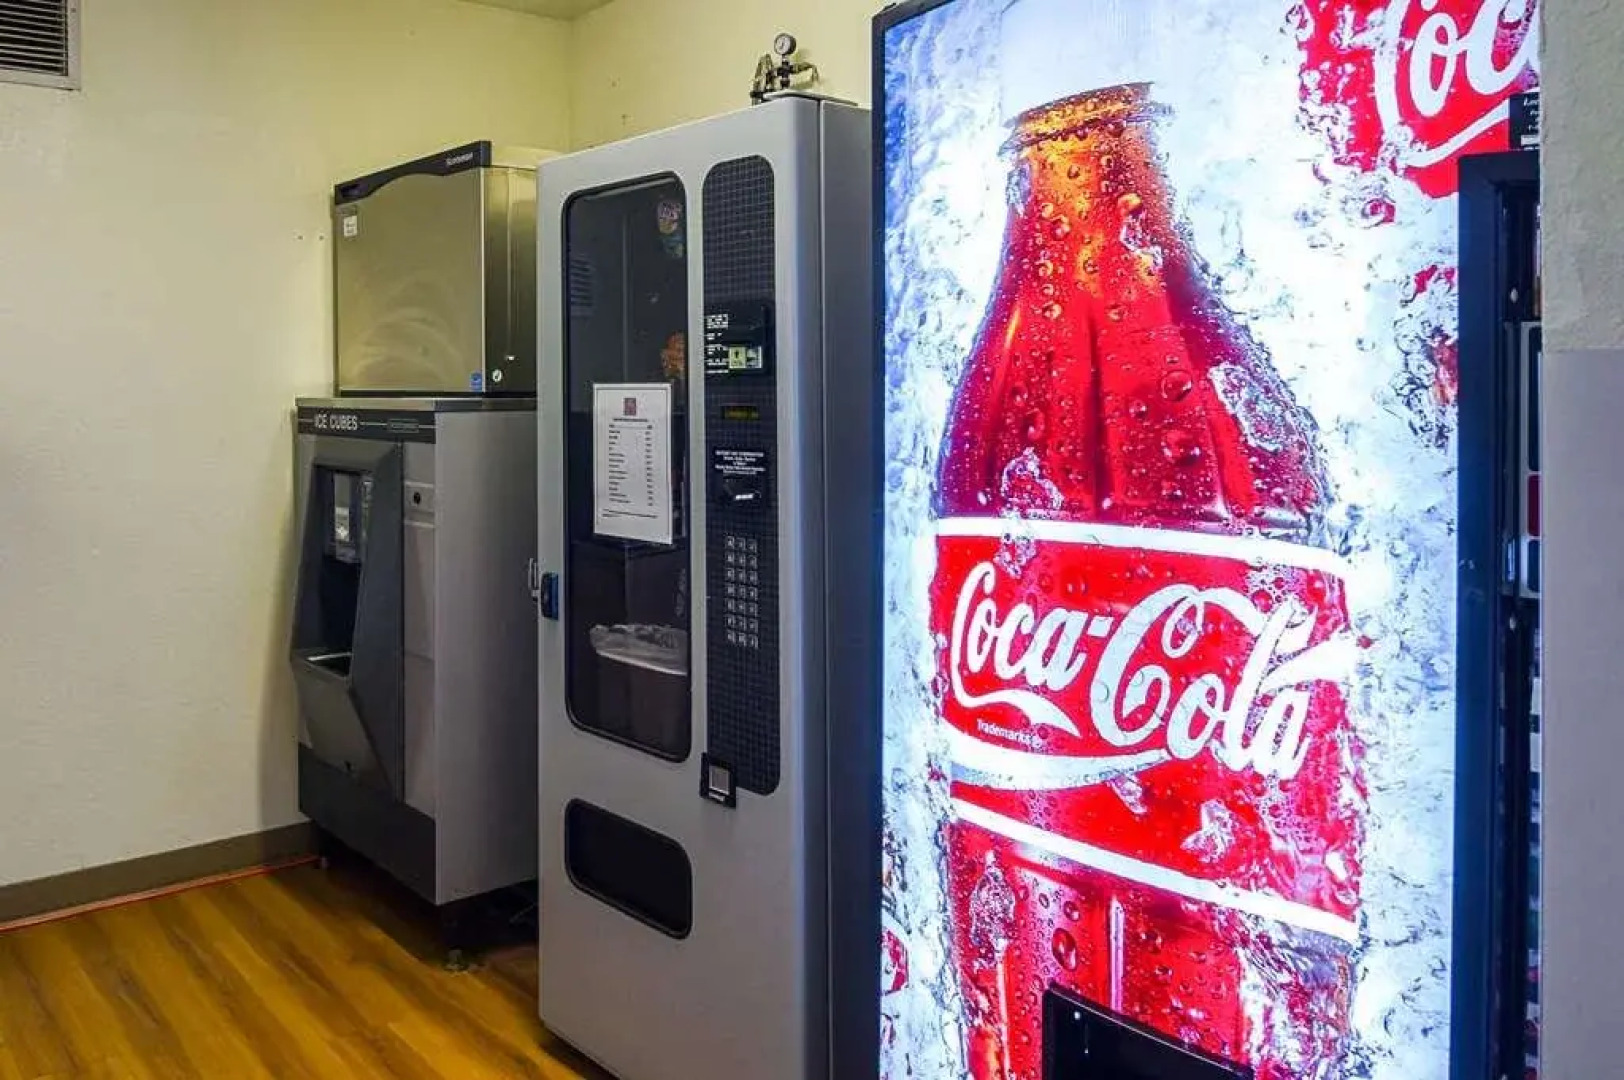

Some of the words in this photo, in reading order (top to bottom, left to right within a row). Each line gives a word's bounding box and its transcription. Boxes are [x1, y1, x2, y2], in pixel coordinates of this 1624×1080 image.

[314, 413, 327, 429] ICE
[329, 415, 357, 430] CUBES
[950, 561, 1322, 782] Coca-Cola
